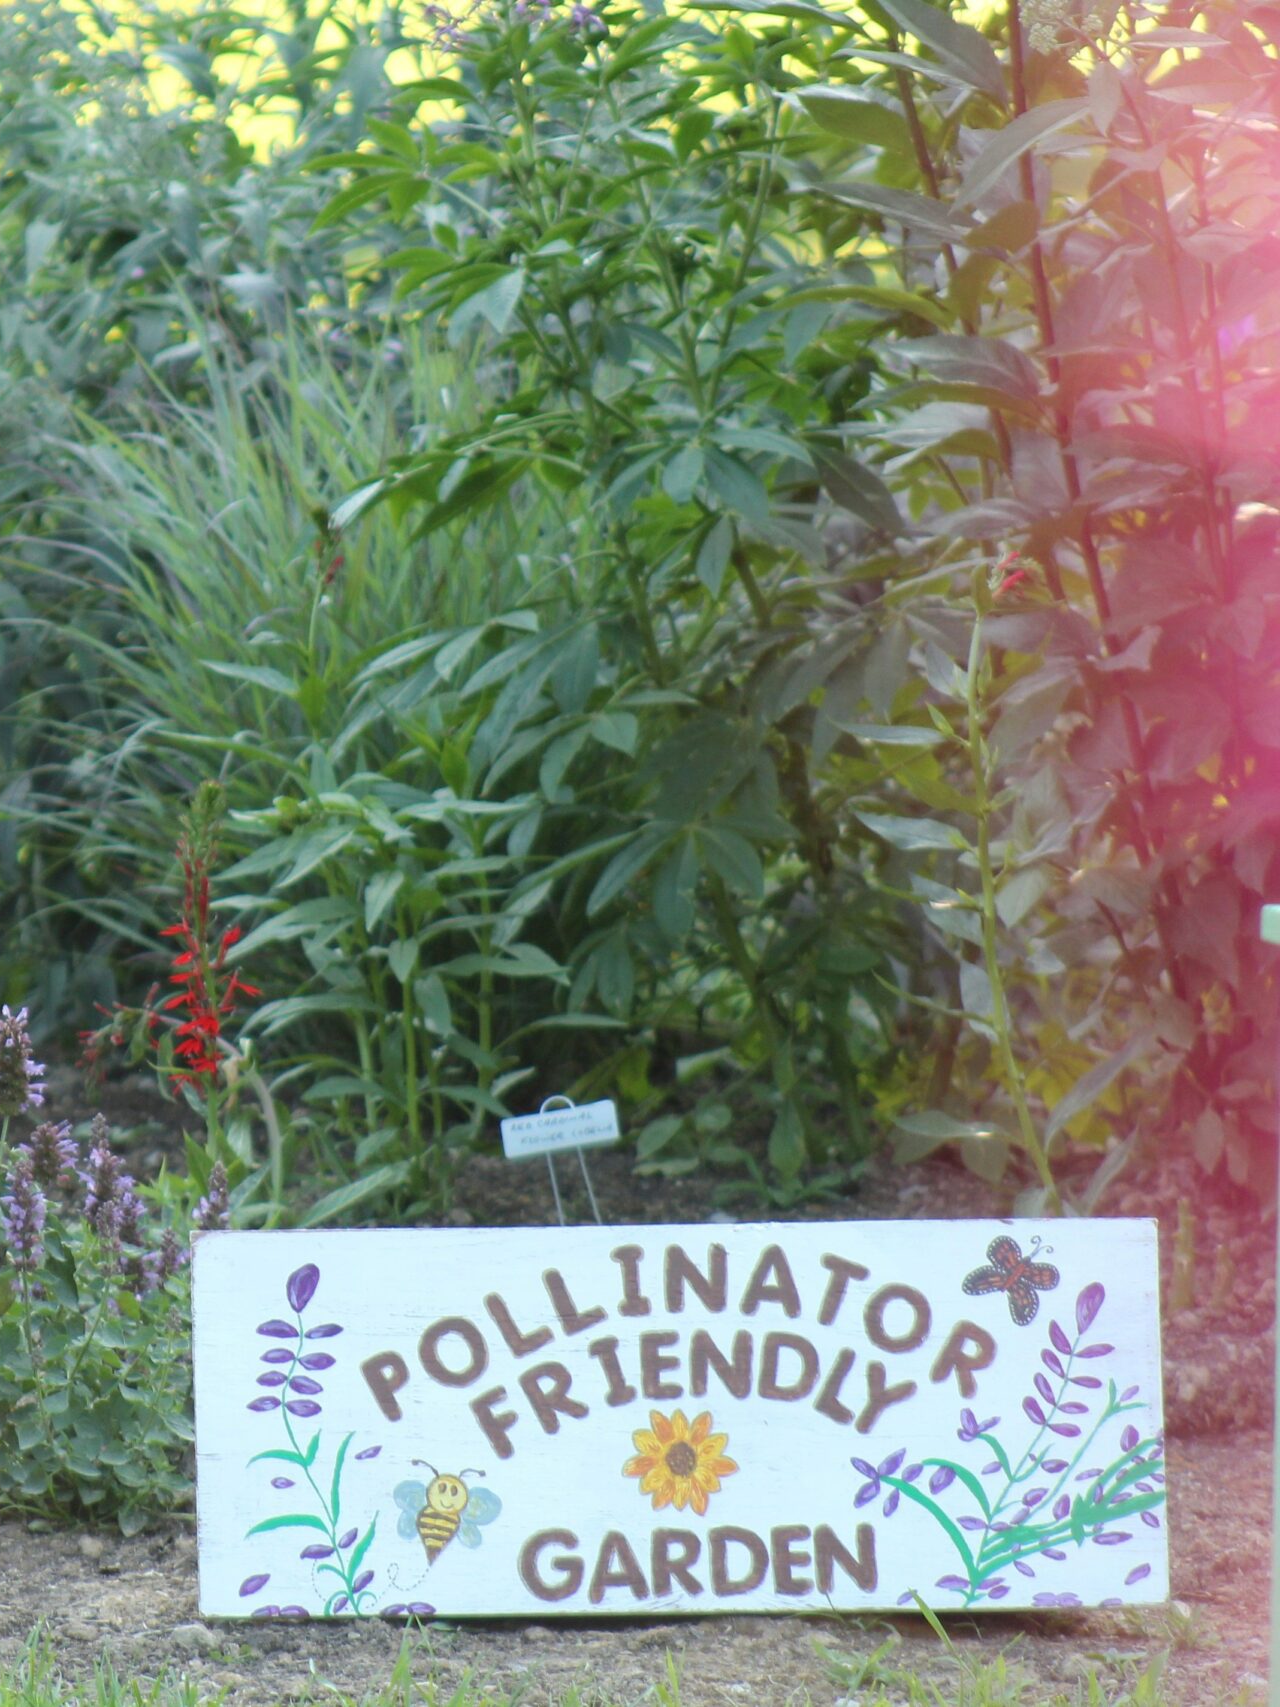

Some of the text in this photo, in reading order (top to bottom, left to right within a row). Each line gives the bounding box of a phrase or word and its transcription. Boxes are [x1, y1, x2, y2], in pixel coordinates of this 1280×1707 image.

[360, 1242, 997, 1421] POLLINATOR
[468, 1330, 916, 1459] FRIENDLY
[519, 1524, 879, 1604] GARDEN
